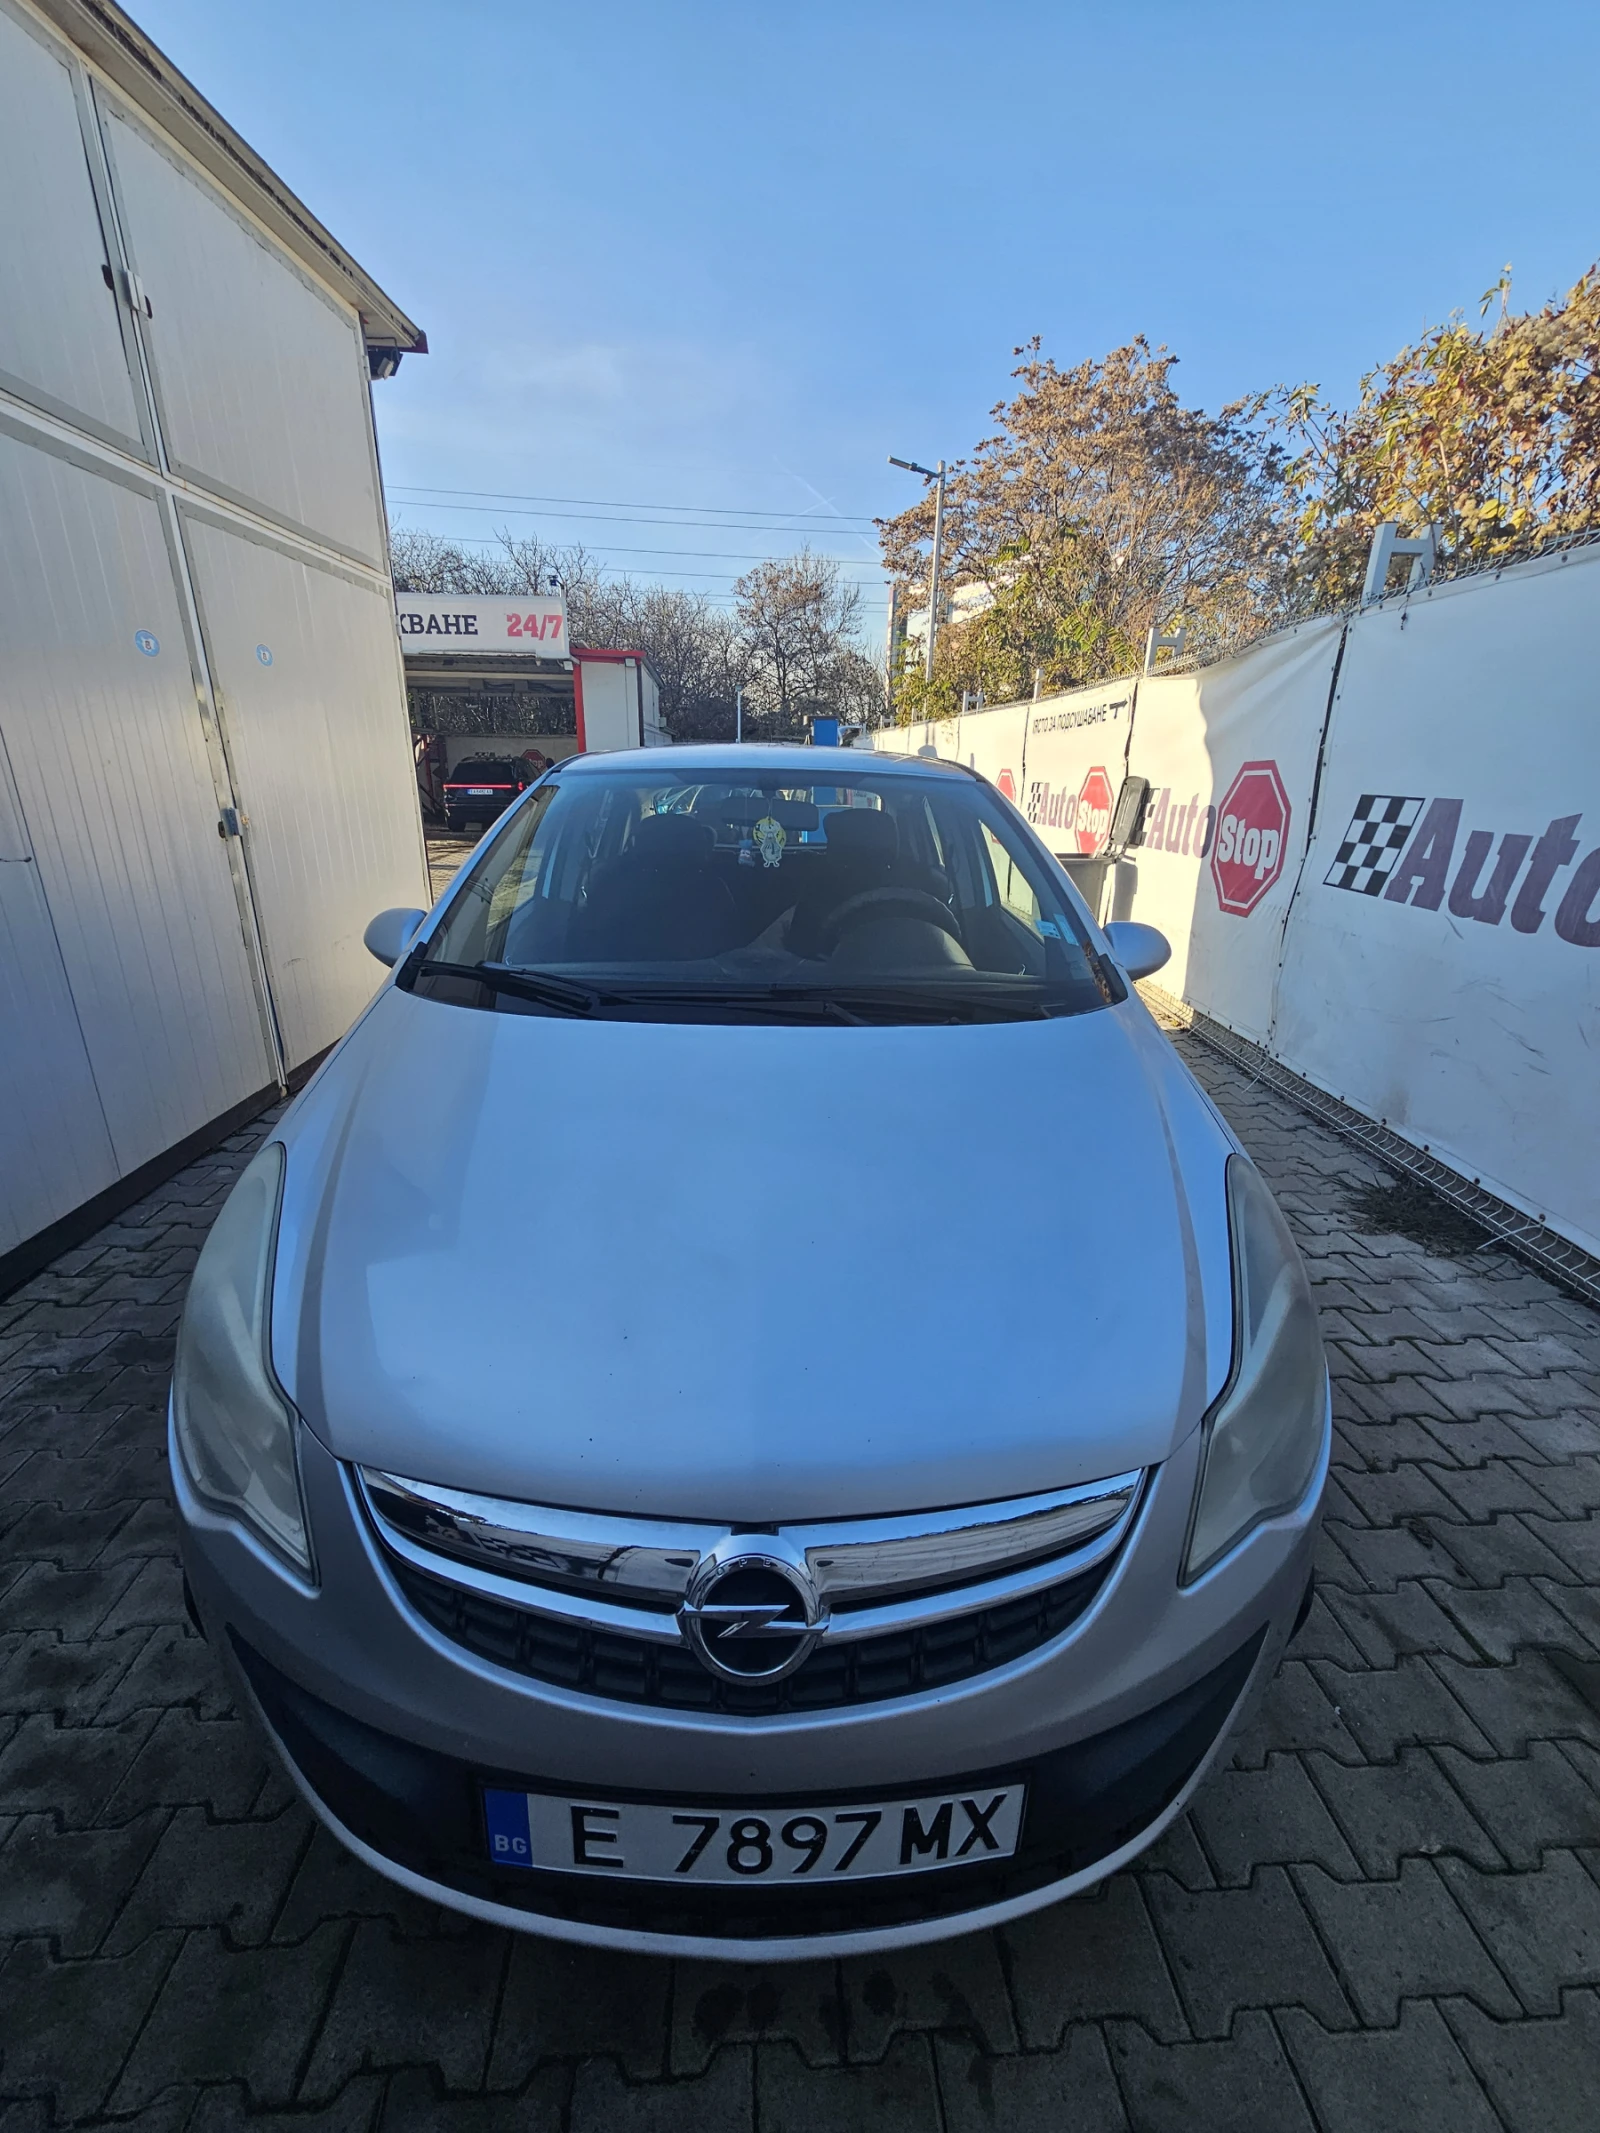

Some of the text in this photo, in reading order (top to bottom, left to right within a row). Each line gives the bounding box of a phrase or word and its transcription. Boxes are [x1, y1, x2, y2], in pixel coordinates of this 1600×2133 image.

[506, 613, 563, 641] 24/7
[1036, 782, 1108, 842] Auto Stop
[1146, 788, 1279, 880] Auto Stop
[716, 1557, 791, 1578] OPEL
[494, 1834, 527, 1854] BG
[570, 1793, 1008, 1875] E 7897 MX
